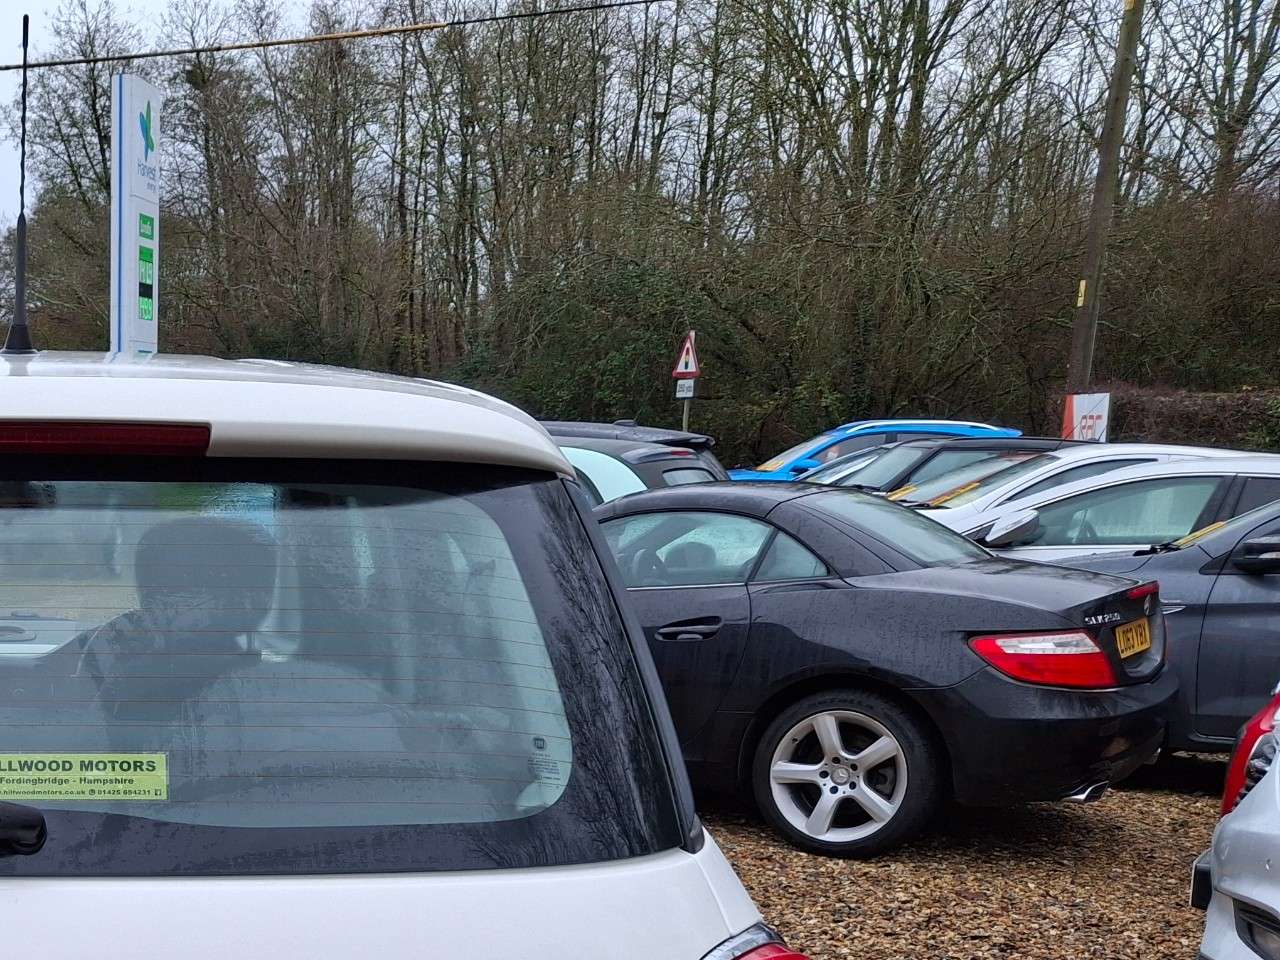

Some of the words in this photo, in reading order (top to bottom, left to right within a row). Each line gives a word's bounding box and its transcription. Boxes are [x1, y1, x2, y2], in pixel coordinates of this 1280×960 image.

[79, 760, 157, 772] MOTORS
[0, 776, 70, 786] Fordingbridge
[79, 776, 135, 786] Hampshire
